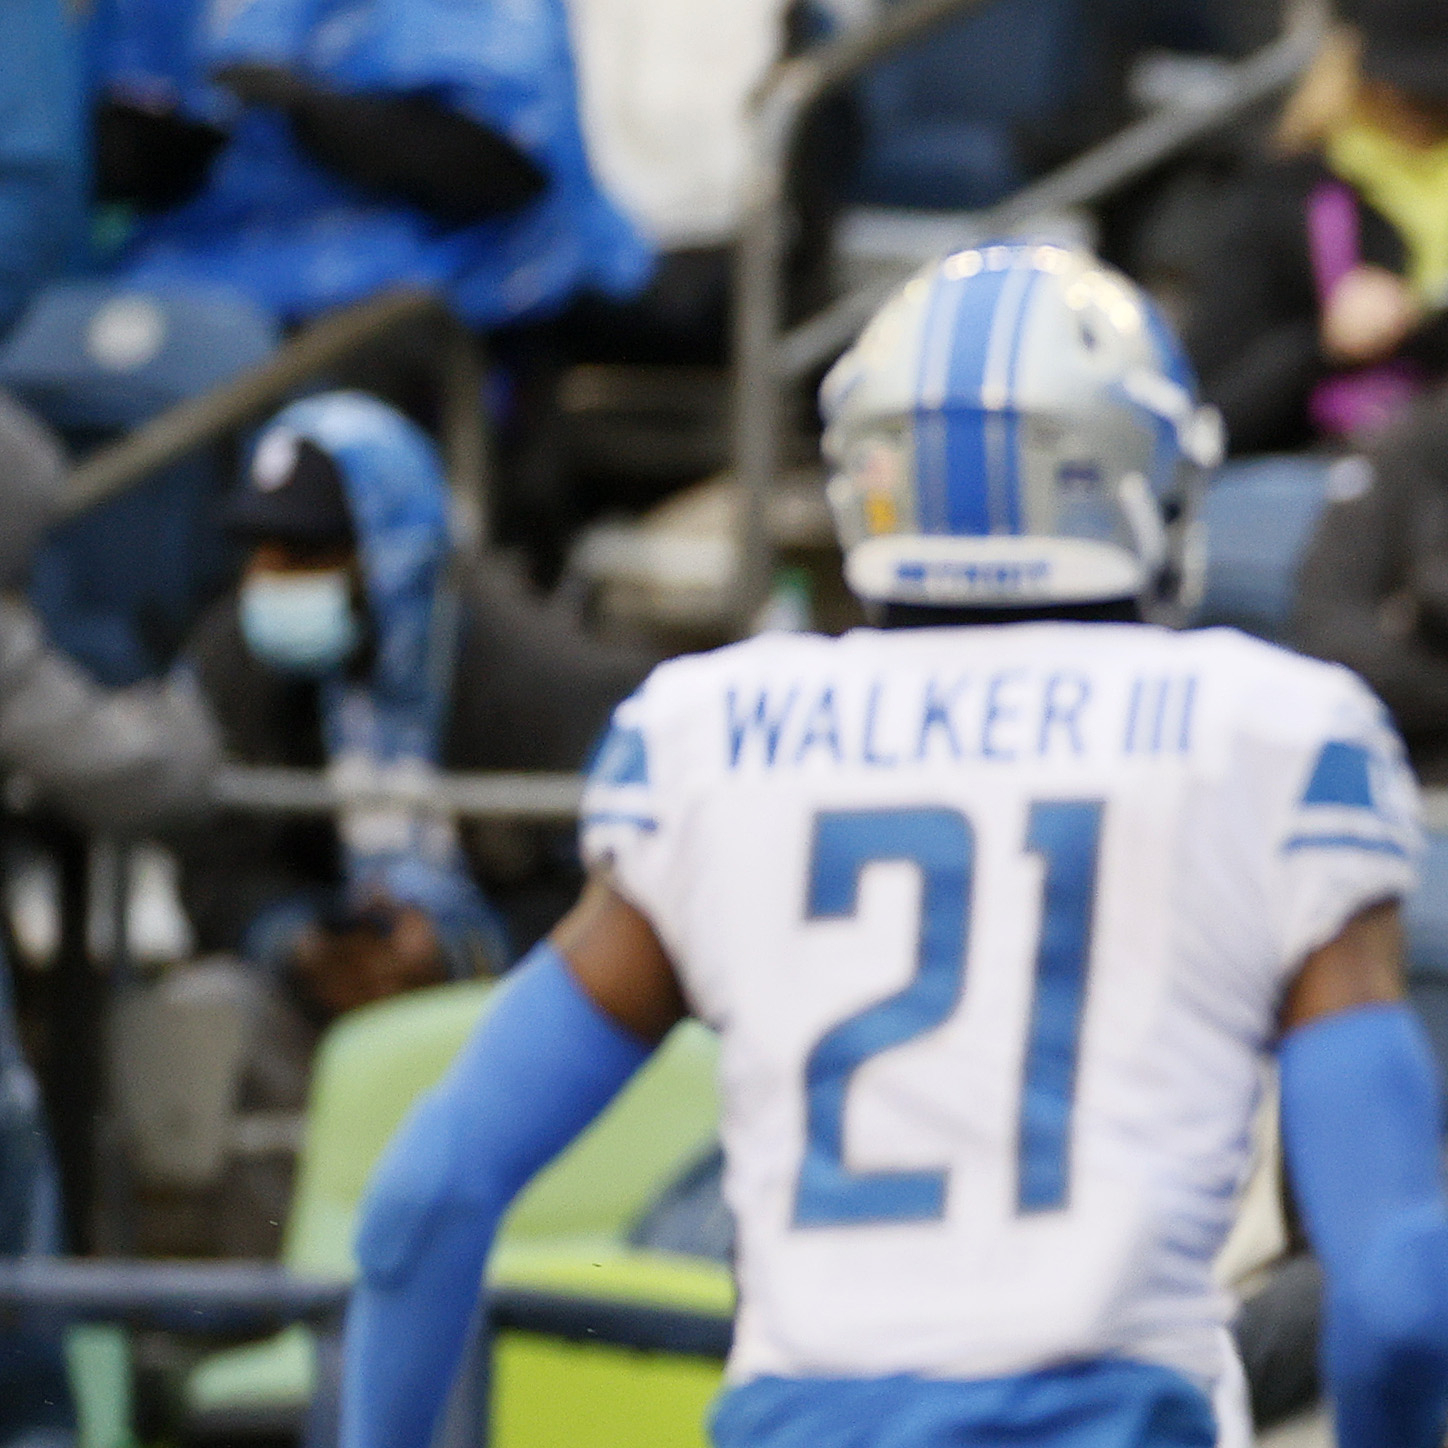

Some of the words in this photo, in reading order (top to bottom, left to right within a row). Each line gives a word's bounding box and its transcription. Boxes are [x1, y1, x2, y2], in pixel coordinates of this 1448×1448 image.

[722, 666, 1094, 772] WALKER
[1122, 668, 1202, 760] III
[791, 797, 1107, 1231] 21
